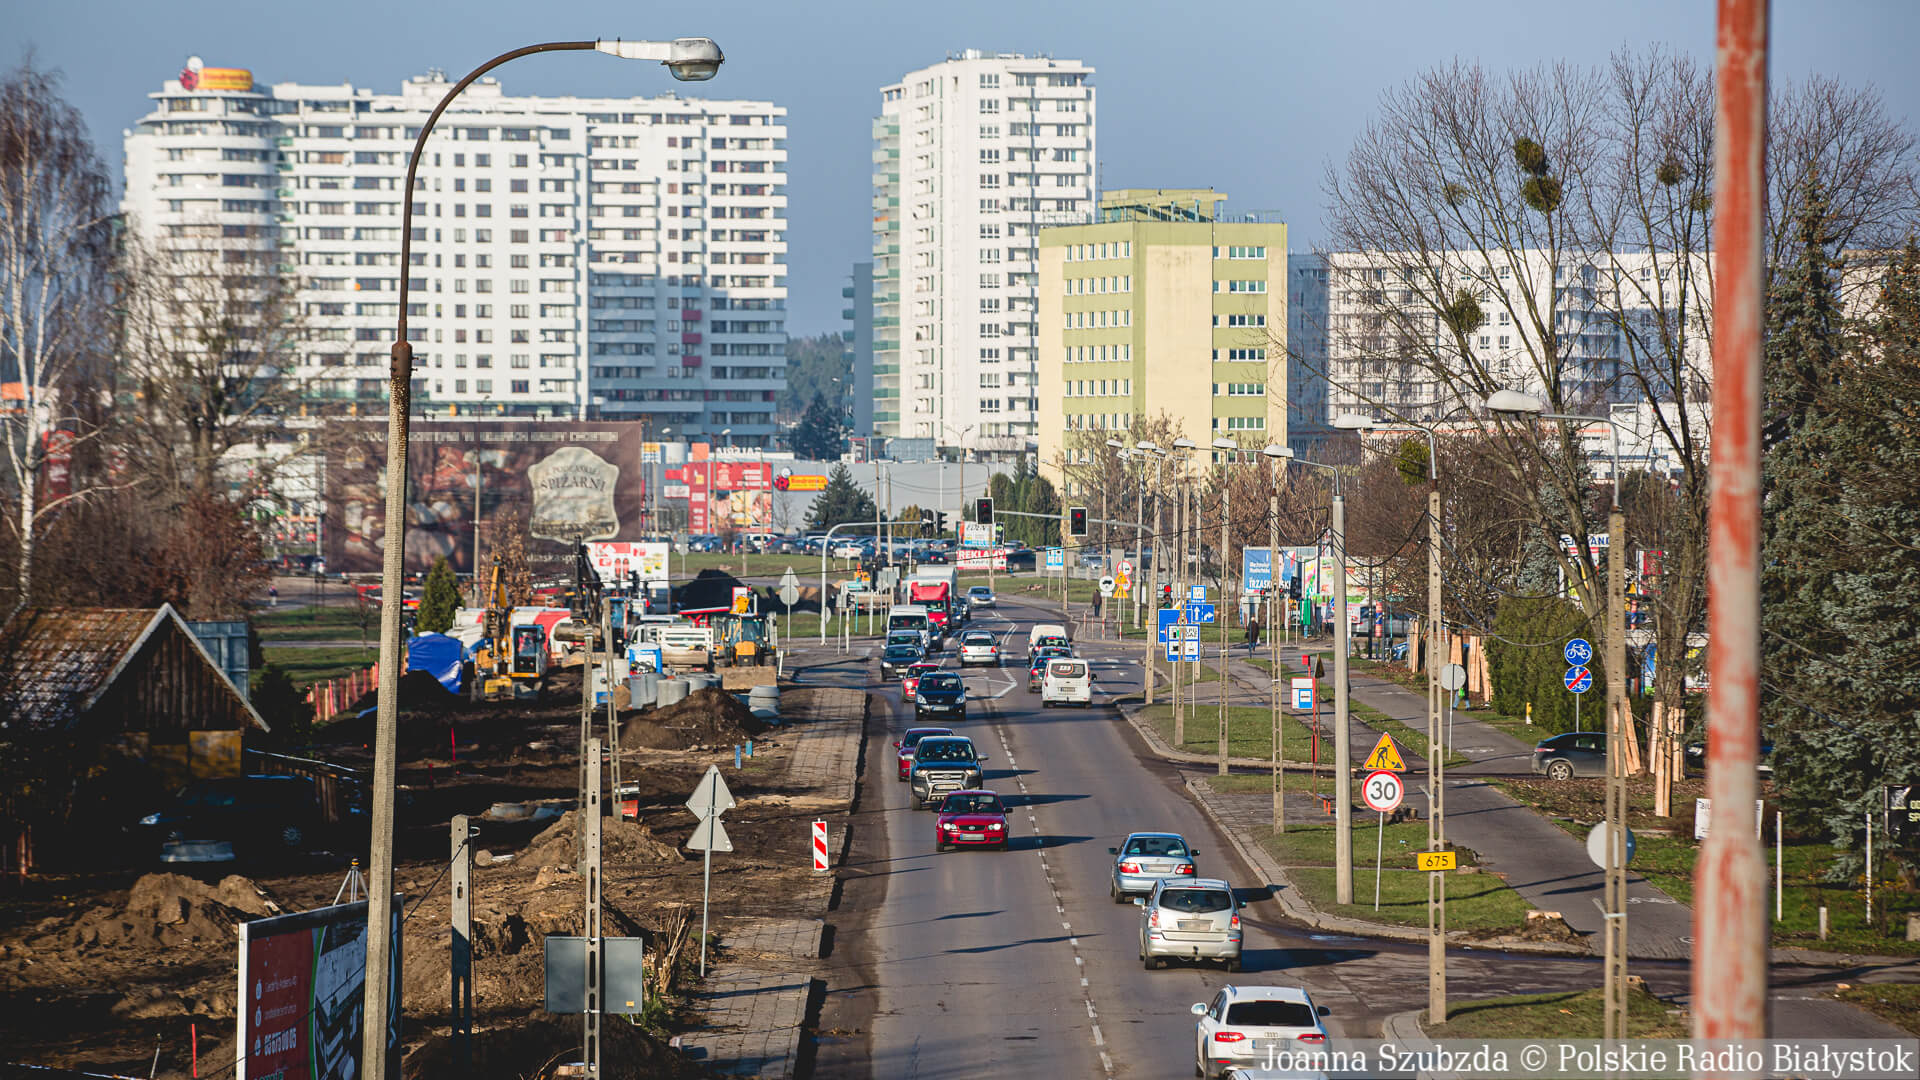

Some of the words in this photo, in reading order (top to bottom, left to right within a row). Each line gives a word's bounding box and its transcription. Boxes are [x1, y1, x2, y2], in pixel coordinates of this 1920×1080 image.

[540, 473, 607, 492] SPIŻARNI
[1249, 579, 1291, 589] TRZASKSKI
[1370, 780, 1396, 801] 30
[1425, 855, 1449, 867] 675
